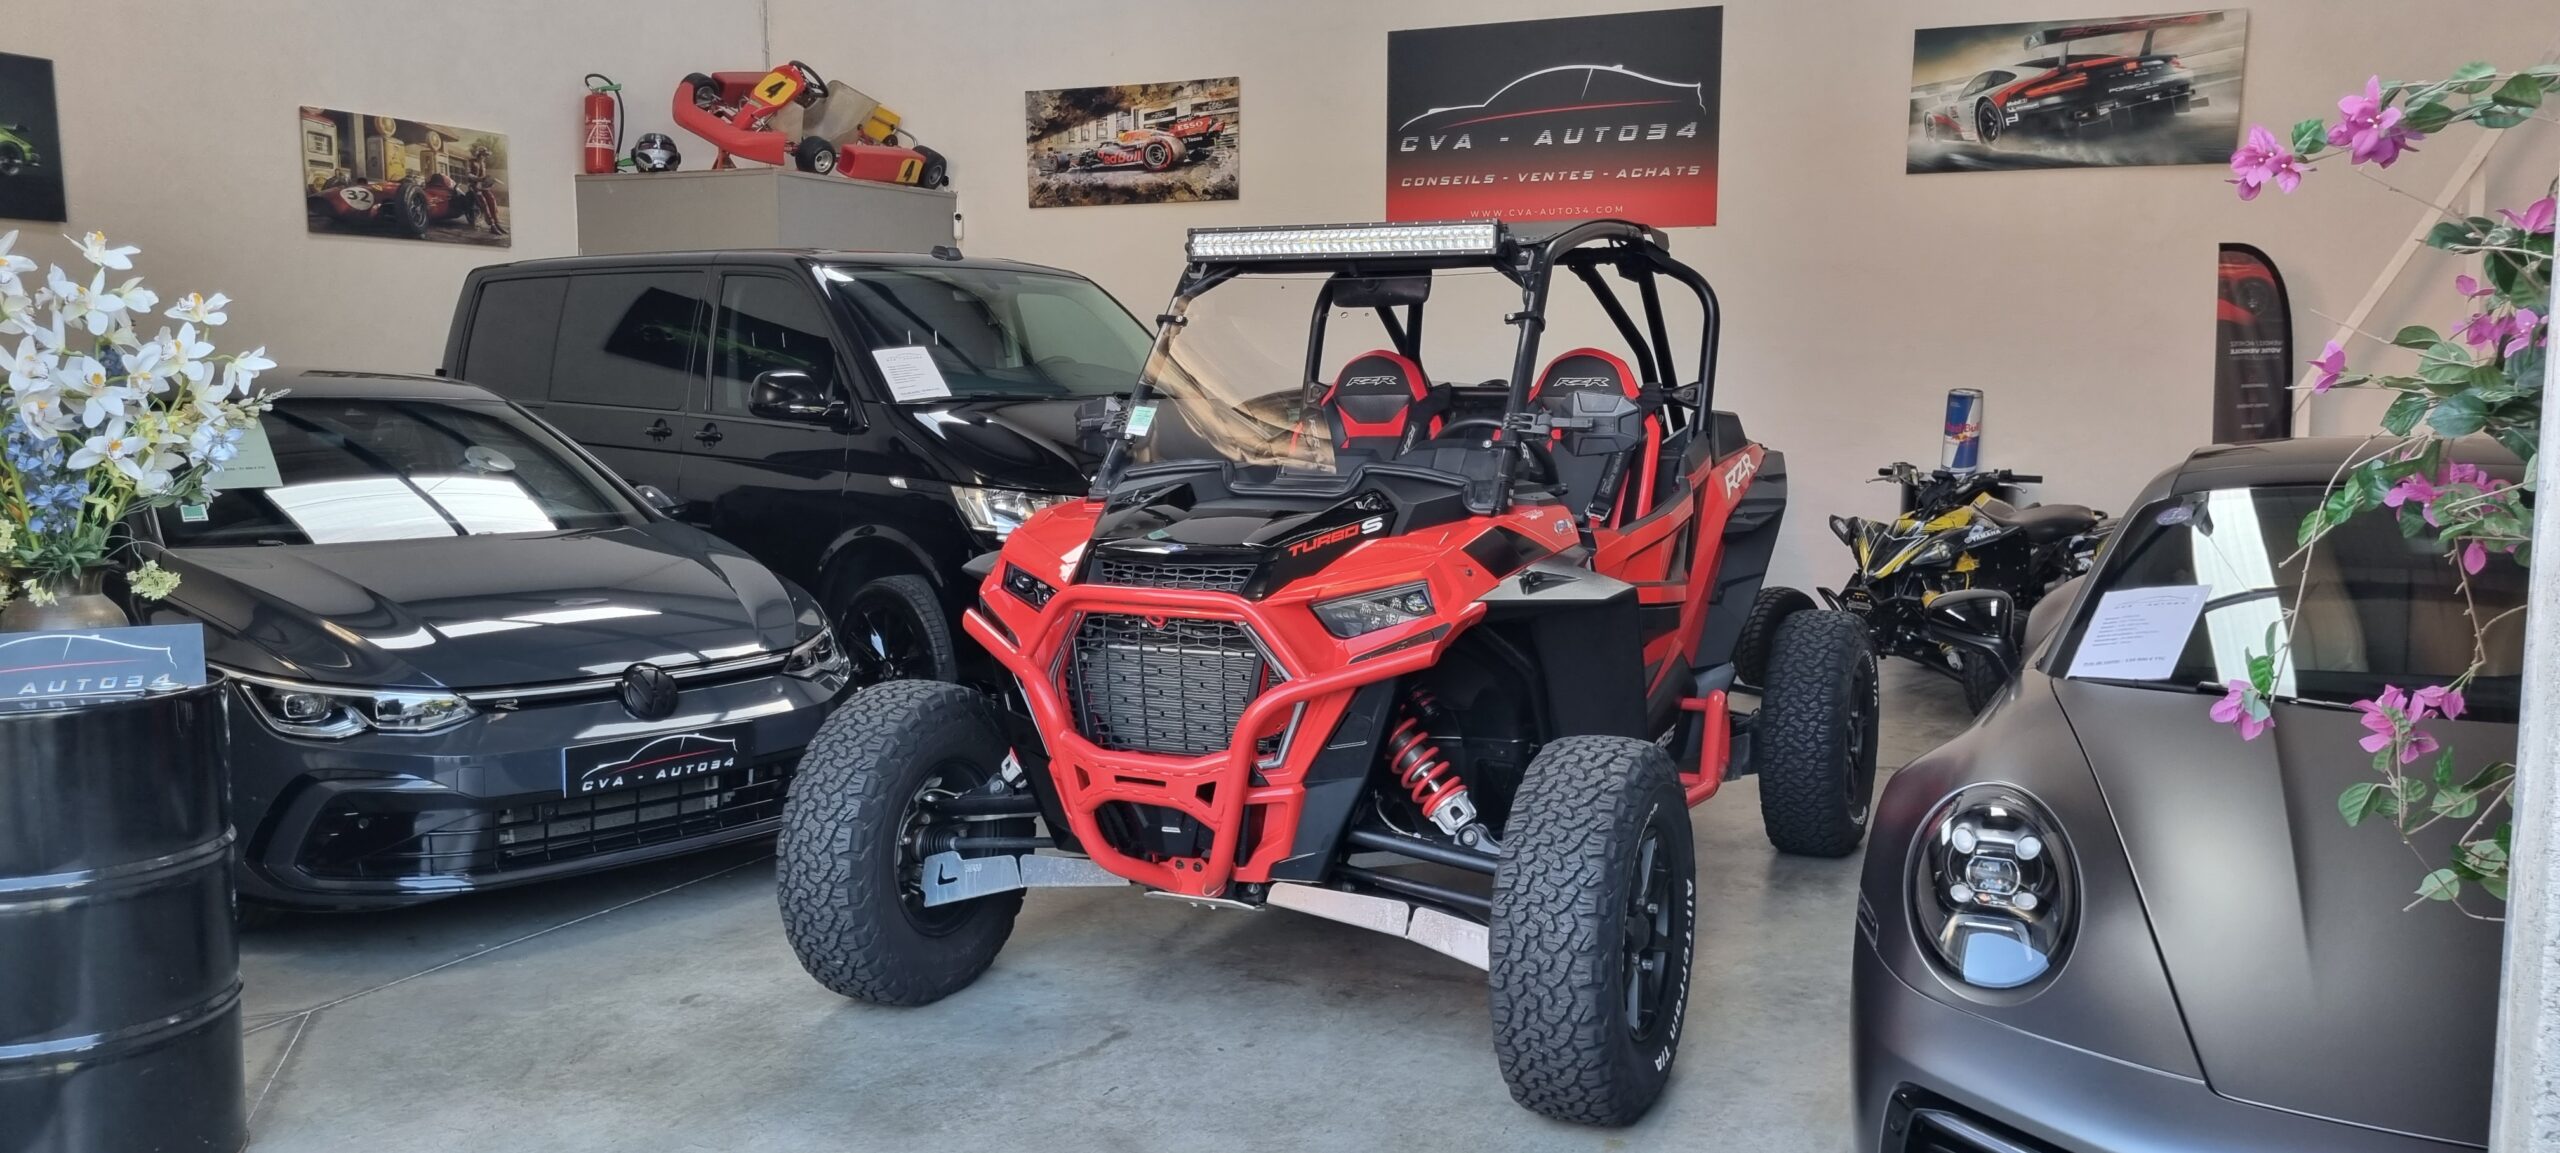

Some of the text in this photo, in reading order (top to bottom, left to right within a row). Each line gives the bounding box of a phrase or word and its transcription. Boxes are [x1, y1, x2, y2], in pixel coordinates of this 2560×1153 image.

[765, 80, 786, 98] 4
[1177, 120, 1204, 131] ESSO
[1400, 133, 1472, 152] CVA
[1533, 121, 1697, 146] AUTO34
[903, 160, 916, 182] 4
[1401, 174, 1496, 188] CONSEILS
[1518, 169, 1594, 183] VENTES
[1615, 165, 1701, 179] ACHATS
[345, 190, 372, 204] 32
[1470, 205, 1624, 218] WWW.CVA-AUTO34.COM
[1345, 375, 1398, 387] RZR
[1553, 376, 1610, 388] RZR
[1724, 453, 1756, 500] RZR
[1288, 516, 1384, 557] TURBO S
[1971, 529, 2002, 543] YAMAHA
[18, 673, 171, 696] AUTO34
[582, 774, 624, 792] CVA
[656, 757, 735, 780] AUTO34
